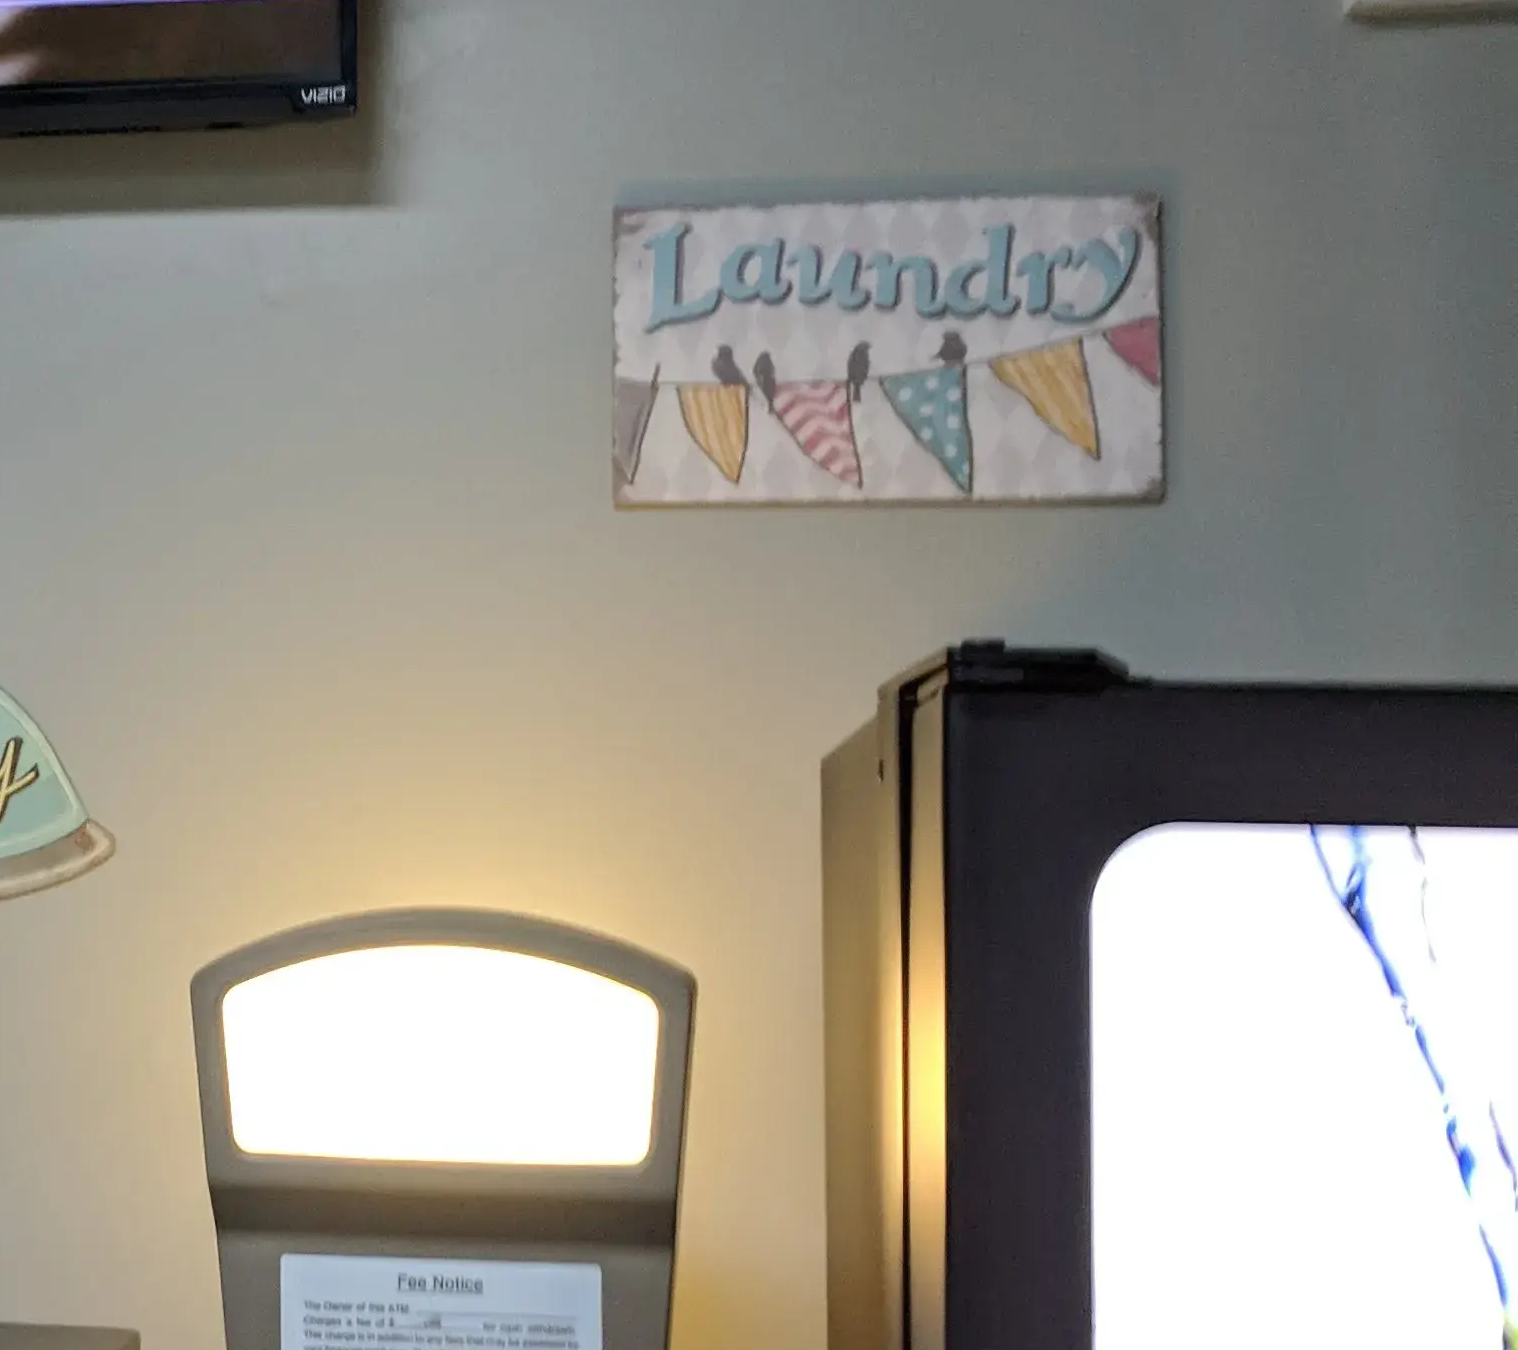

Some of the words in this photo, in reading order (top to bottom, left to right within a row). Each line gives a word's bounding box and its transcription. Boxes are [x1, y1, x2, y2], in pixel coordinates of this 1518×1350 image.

[301, 85, 346, 104] VIZIO
[643, 221, 1144, 335] Laundry
[397, 1272, 428, 1292] Fee
[433, 1275, 484, 1295] Notice
